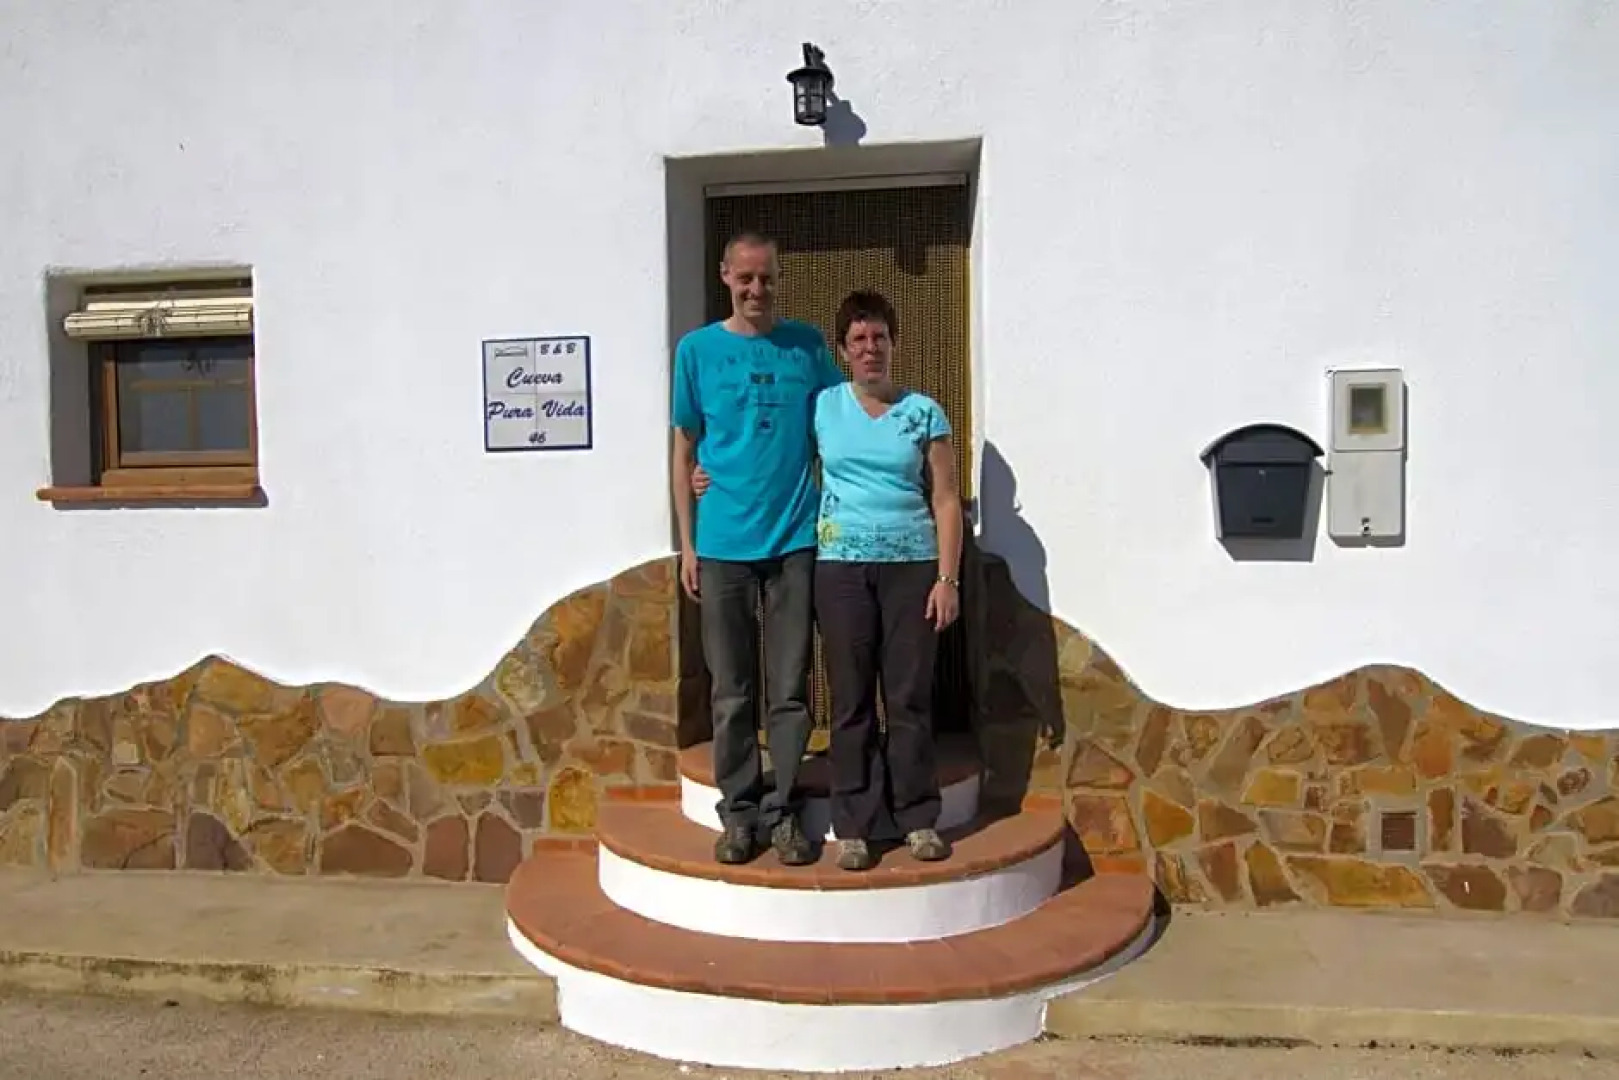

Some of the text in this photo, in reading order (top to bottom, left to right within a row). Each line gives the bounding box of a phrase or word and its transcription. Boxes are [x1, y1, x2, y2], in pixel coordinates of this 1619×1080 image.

[540, 343, 550, 355] B
[566, 342, 576, 354] B
[506, 366, 563, 388] Cueva
[488, 399, 585, 420] Pura Vida
[528, 432, 546, 444] 46
